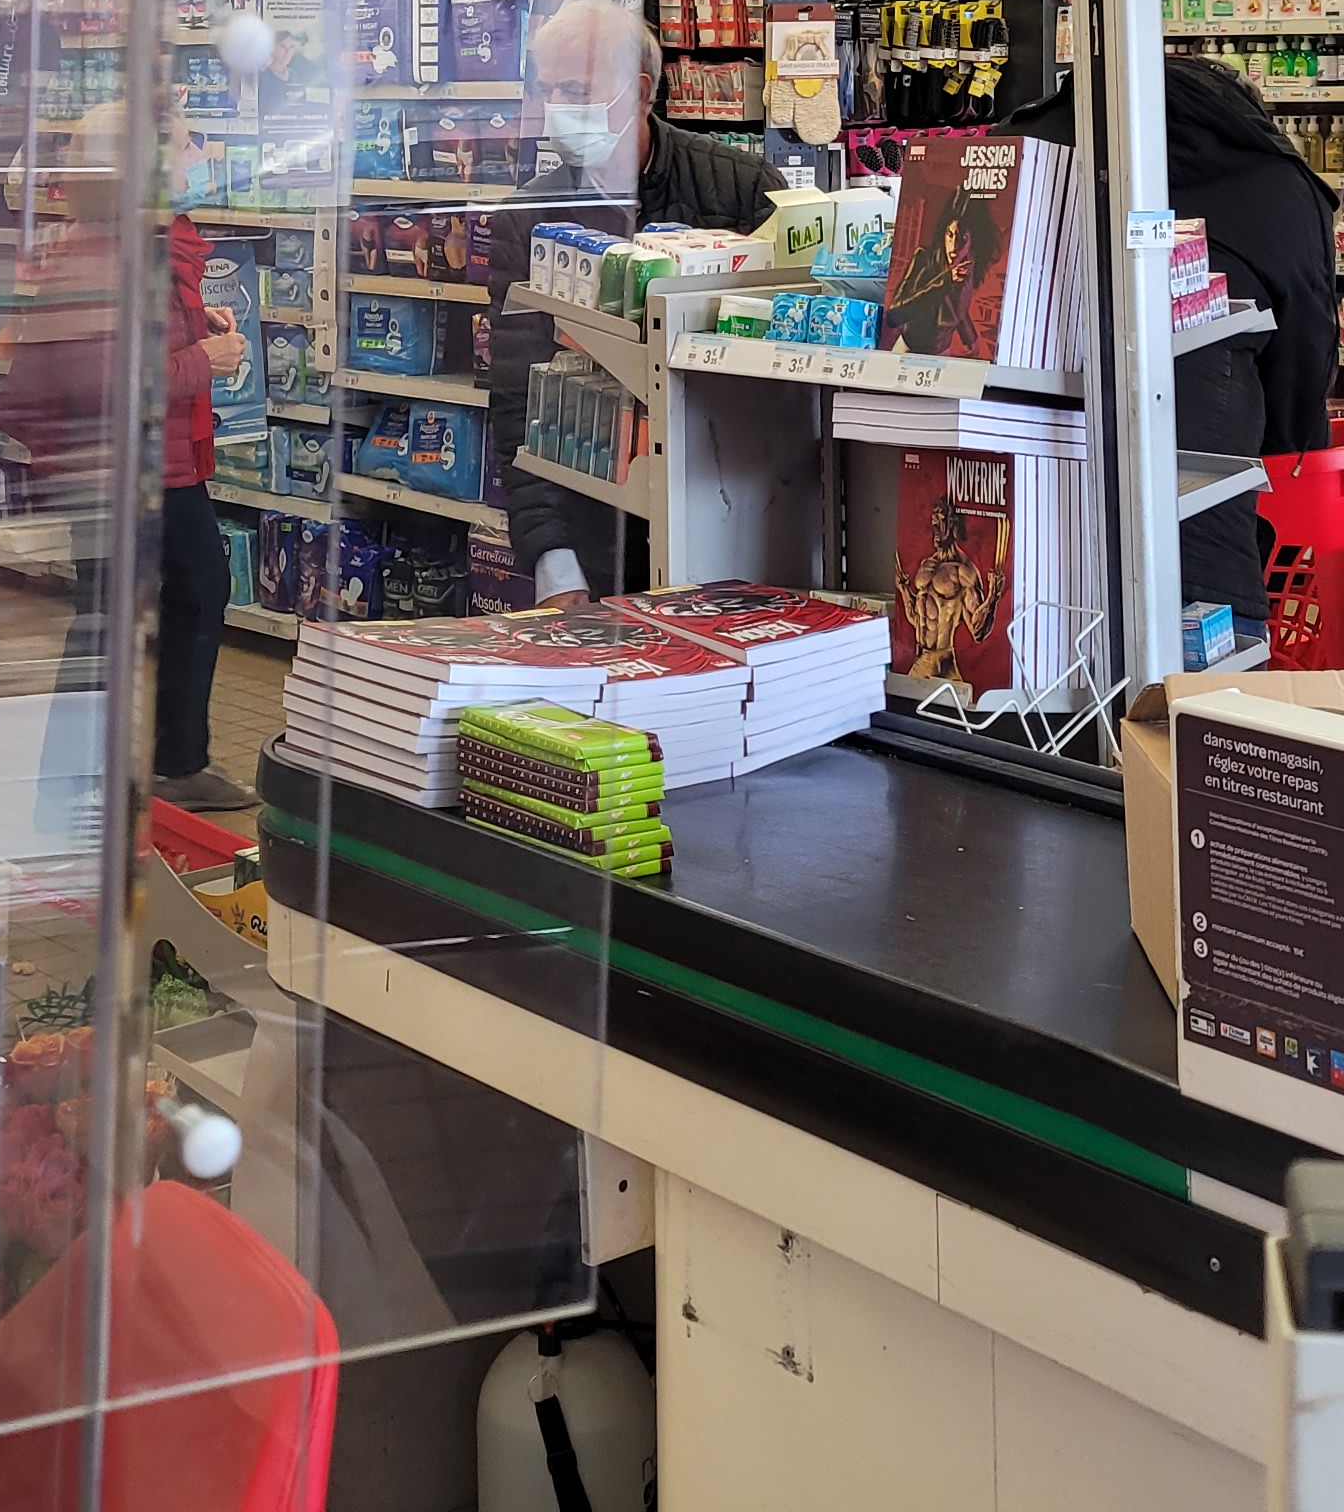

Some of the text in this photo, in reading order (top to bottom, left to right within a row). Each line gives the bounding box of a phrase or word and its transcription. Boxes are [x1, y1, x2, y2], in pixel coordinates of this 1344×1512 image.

[961, 145, 1016, 168] JESSICA
[964, 169, 1008, 191] JONES
[946, 456, 1006, 505] WOLVERINE
[470, 543, 515, 567] Carrefour
[471, 592, 513, 613] Absodus
[1203, 732, 1324, 776] dans votre magasin,
[1208, 753, 1319, 793] réglez votre repas
[1204, 775, 1325, 816] en titres restaurant
